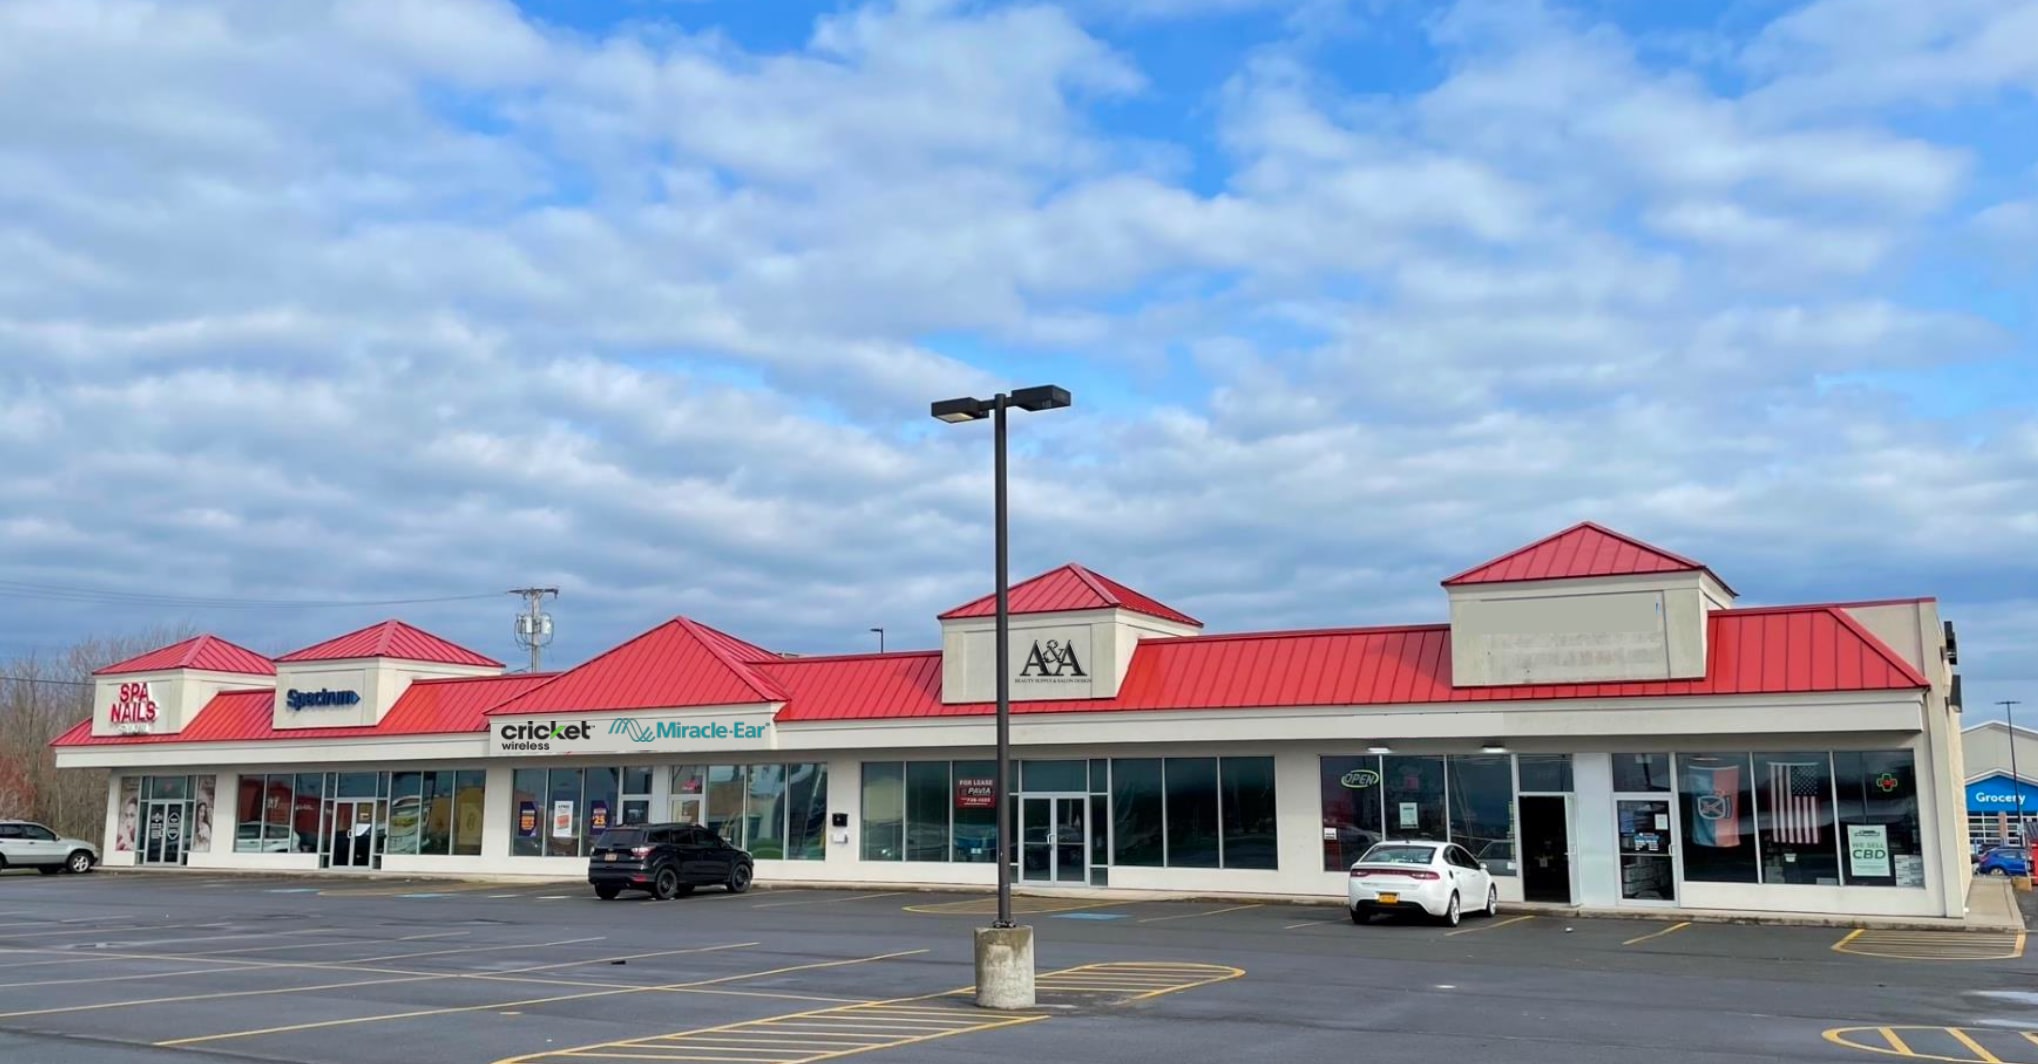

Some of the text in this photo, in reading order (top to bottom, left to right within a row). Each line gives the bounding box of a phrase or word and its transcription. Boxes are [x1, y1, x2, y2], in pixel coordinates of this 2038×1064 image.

[1019, 639, 1087, 677] A&A
[120, 682, 149, 703] SPA
[287, 688, 352, 711] Spectrum
[111, 701, 156, 723] NAILS
[500, 720, 591, 740] cricket
[502, 741, 550, 751] wireless
[1344, 773, 1376, 786] OPEN
[1975, 791, 2026, 805] Grocery
[1852, 849, 1886, 859] CBD
